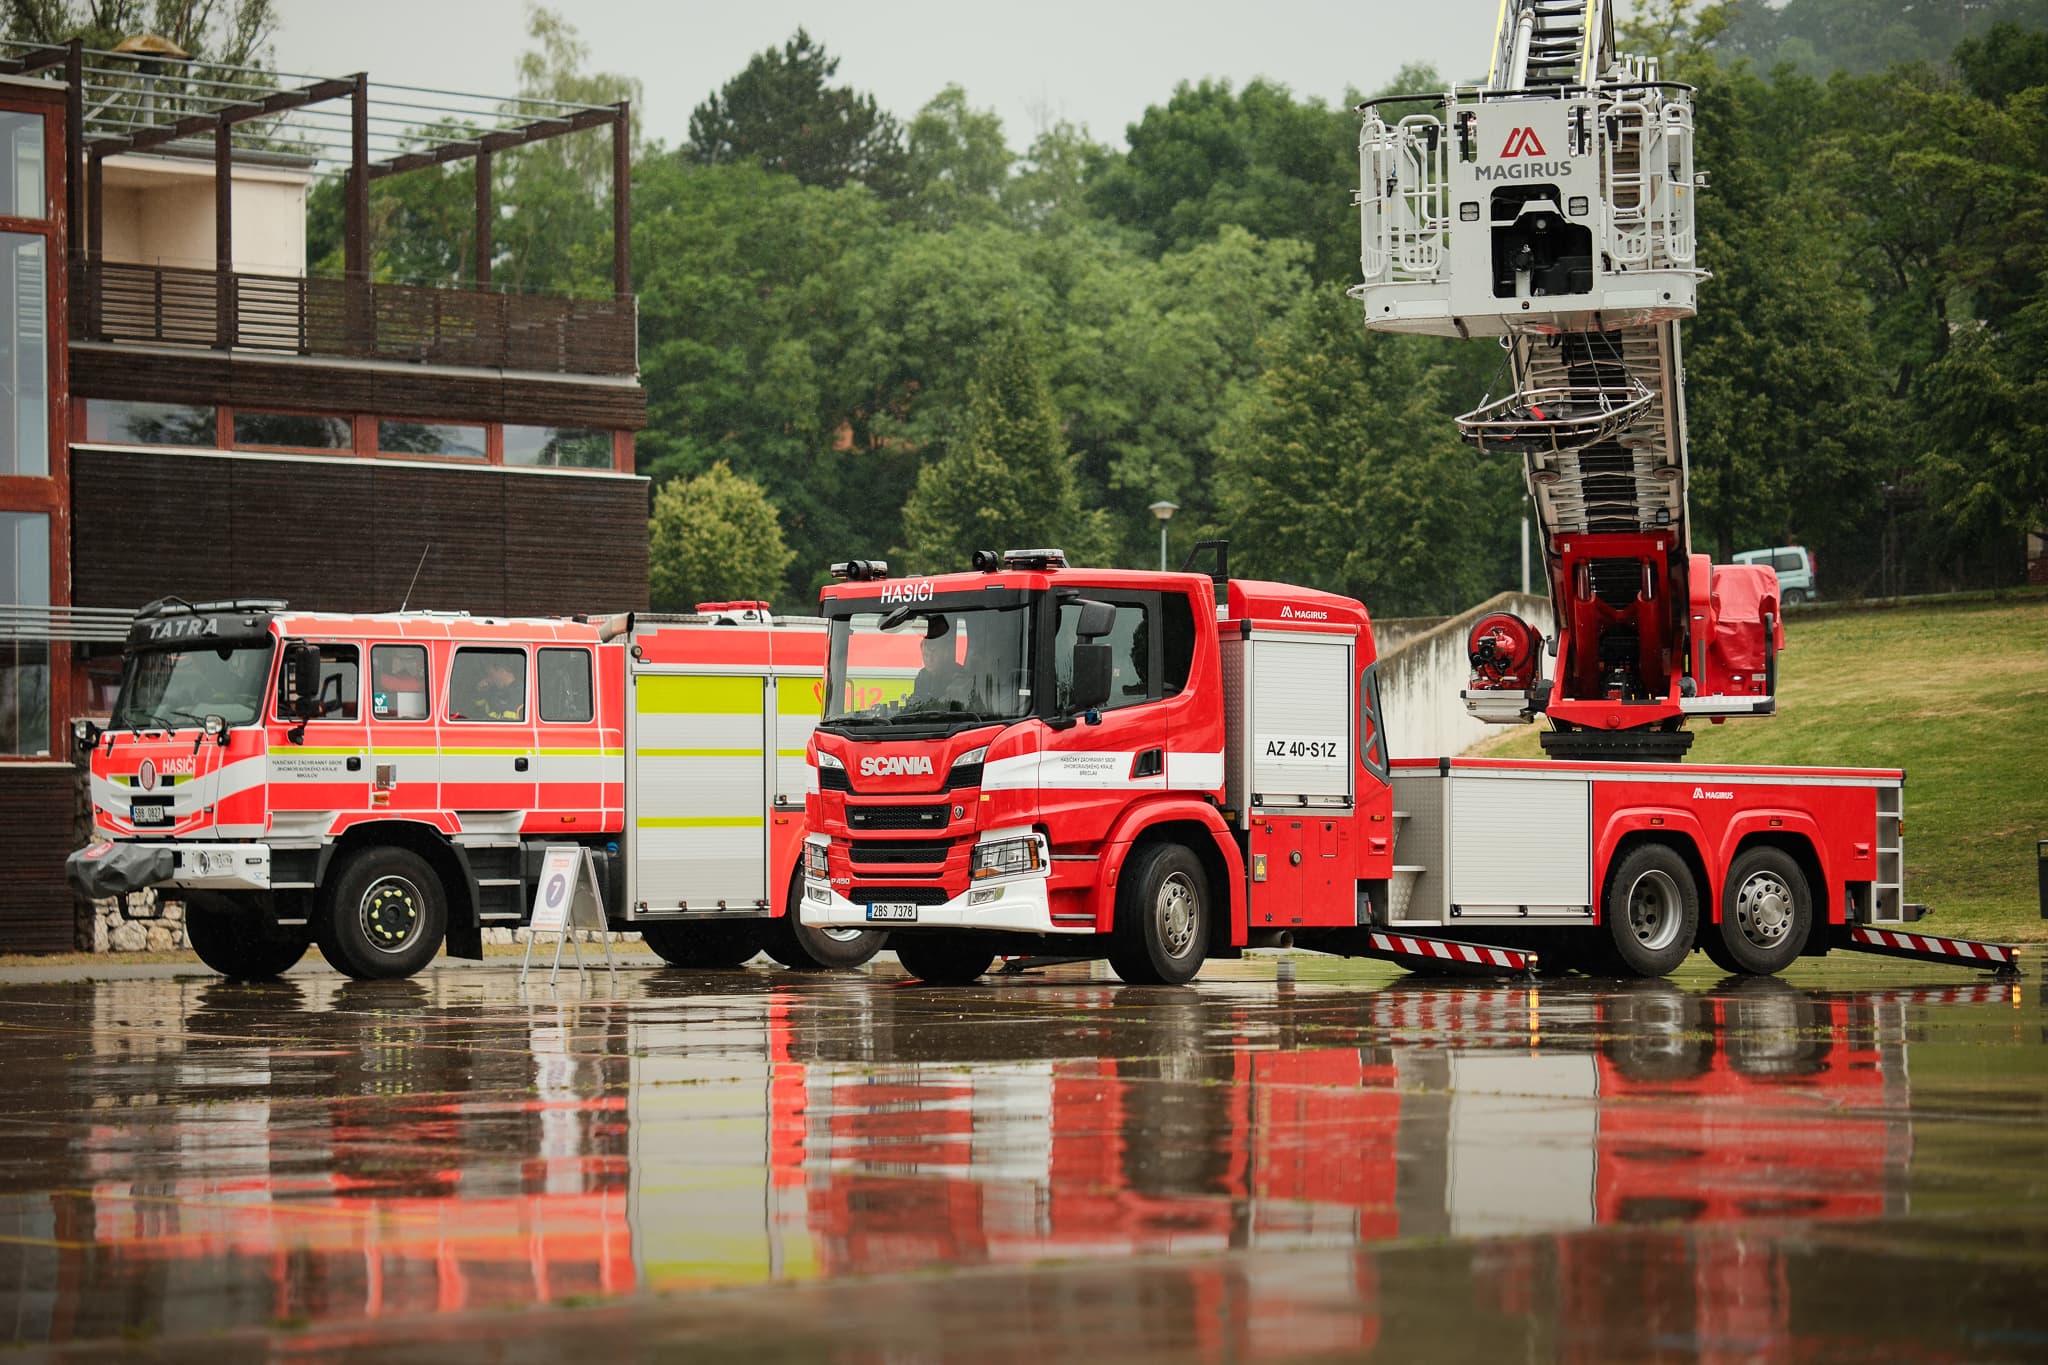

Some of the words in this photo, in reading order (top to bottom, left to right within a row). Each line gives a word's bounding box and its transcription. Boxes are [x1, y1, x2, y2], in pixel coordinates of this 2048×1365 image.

[1475, 160, 1572, 181] MAGIRUS
[880, 580, 935, 604] HASIČI
[1294, 610, 1328, 620] MAGIRUS
[150, 618, 218, 640] TATRA
[1266, 740, 1286, 757] AZ
[1289, 741, 1337, 758] 40-S1Z
[162, 755, 196, 774] HASIČI
[860, 755, 935, 776] SCANIA
[1705, 791, 1734, 800] MAGIRUS
[550, 880, 562, 901] 7
[873, 905, 888, 917] 2BS
[893, 905, 913, 918] 7378
